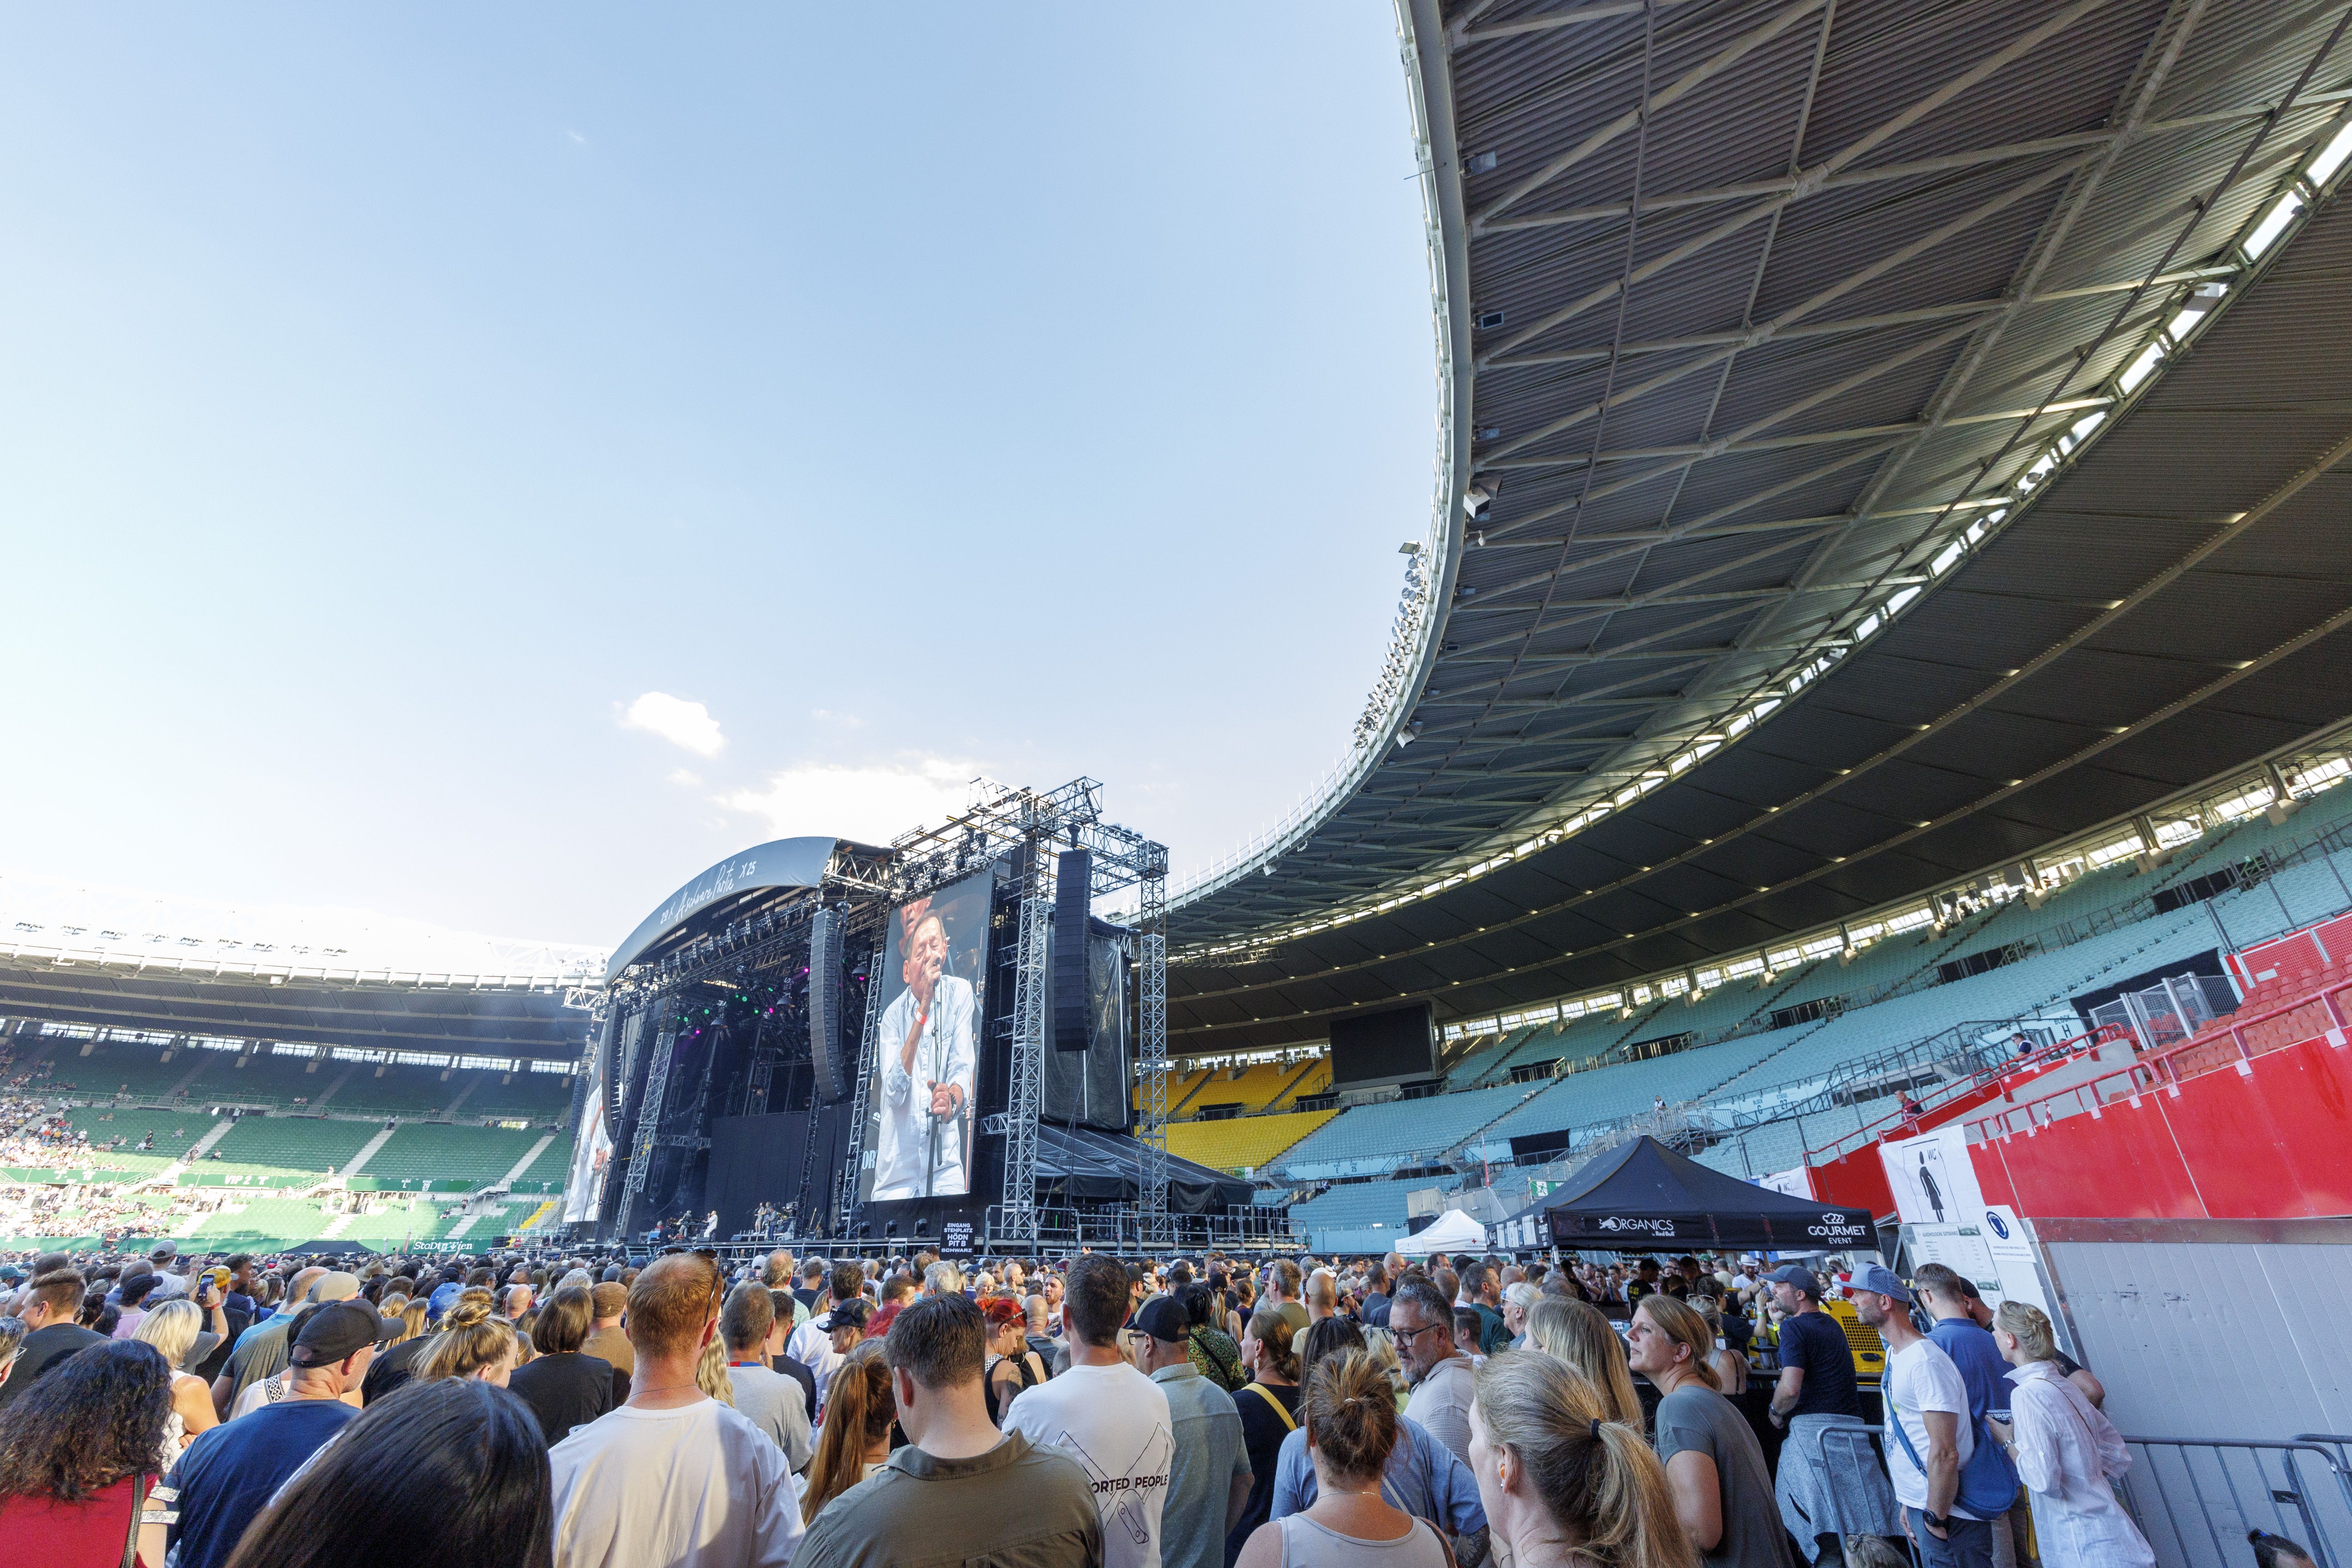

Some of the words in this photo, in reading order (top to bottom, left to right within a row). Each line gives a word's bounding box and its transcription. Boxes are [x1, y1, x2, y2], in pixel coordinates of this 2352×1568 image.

[2062, 1024, 2072, 1038] H
[1757, 1105, 1763, 1114] G
[1780, 1099, 1788, 1110] 27
[862, 1150, 877, 1170] OR
[1927, 1148, 1936, 1161] WC
[225, 1175, 243, 1184] VIP
[243, 1175, 252, 1185] 2
[1609, 1217, 1674, 1231] ORGANICS
[1808, 1226, 1865, 1236] GOURMET
[1135, 1475, 1168, 1489] PEOPLE
